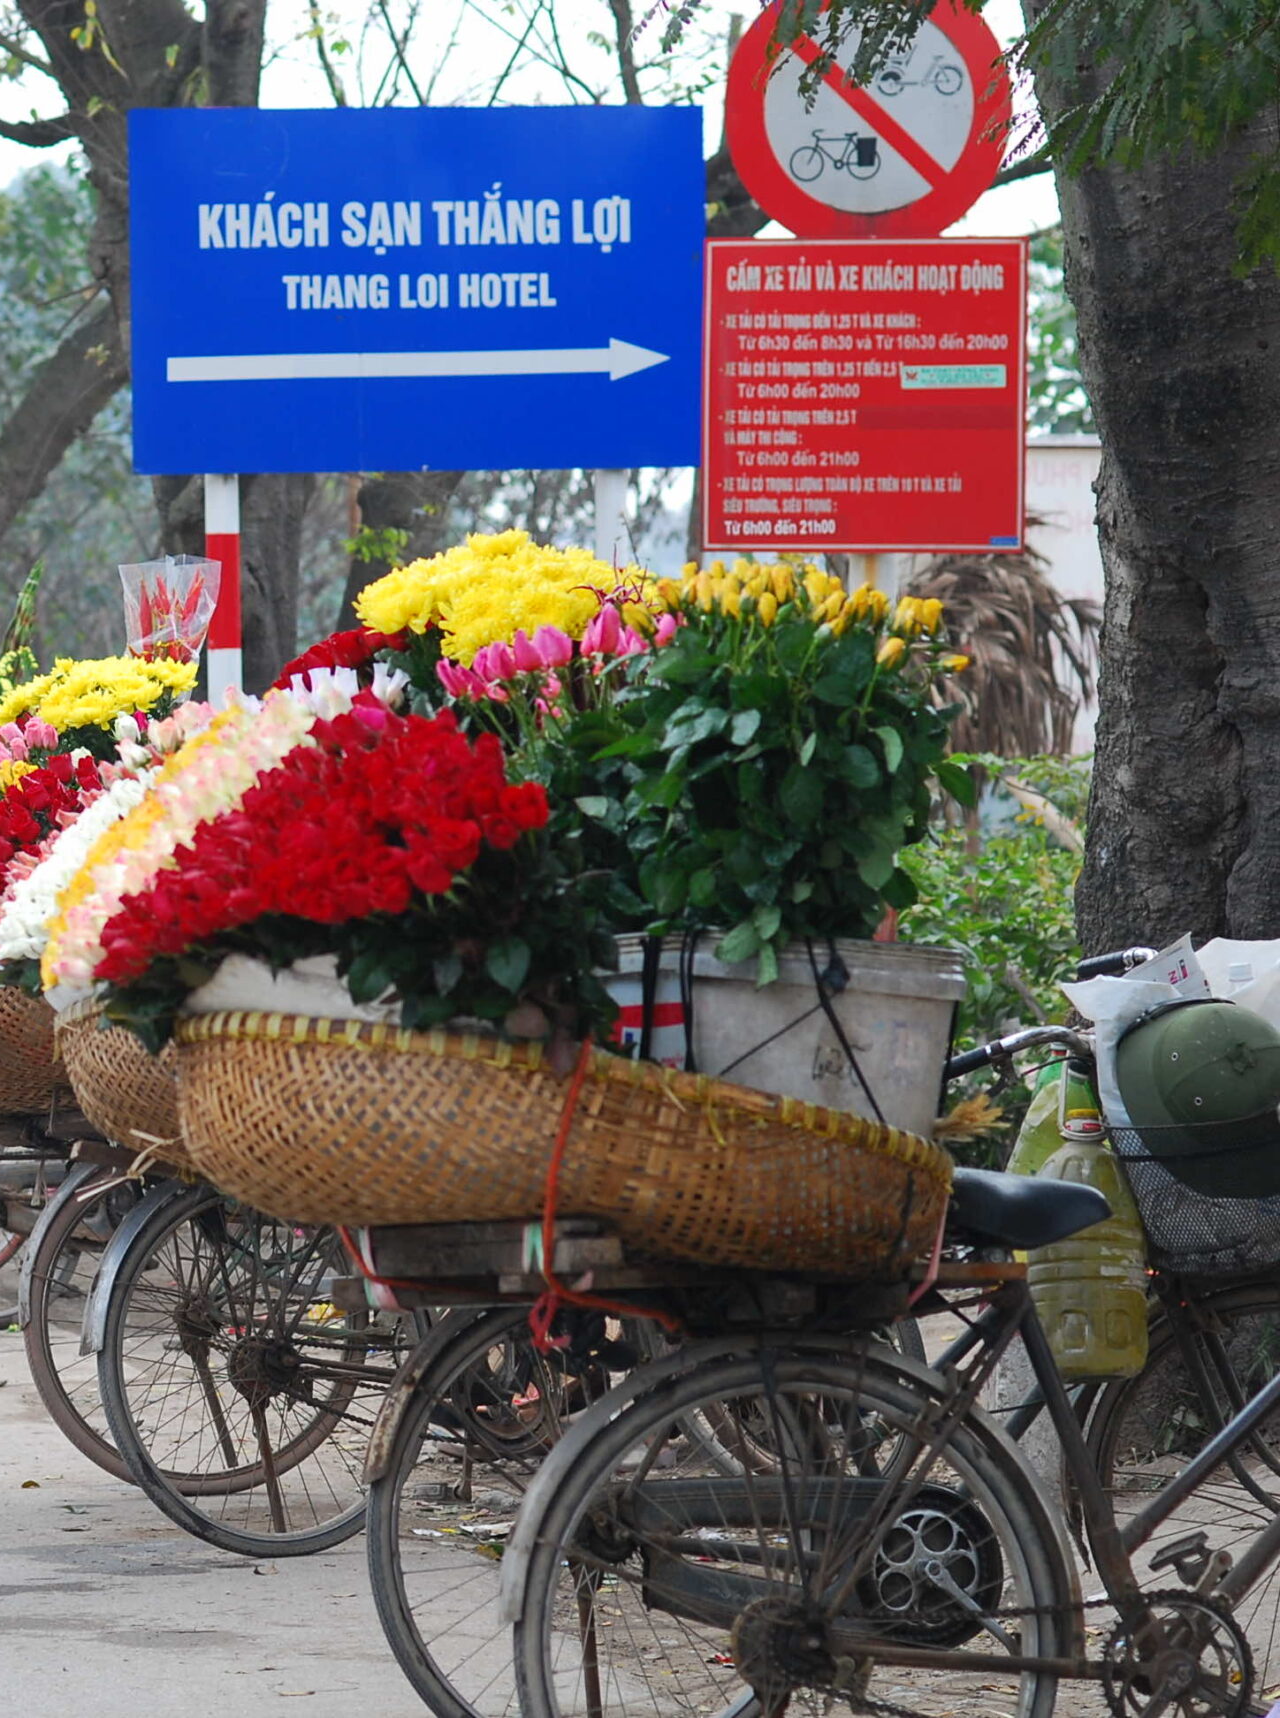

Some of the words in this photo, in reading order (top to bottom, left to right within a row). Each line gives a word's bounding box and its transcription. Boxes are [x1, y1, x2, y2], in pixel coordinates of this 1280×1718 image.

[198, 191, 329, 249] KHÁCH
[341, 201, 421, 255] SẠN
[432, 182, 560, 246] THẮNG
[572, 195, 631, 253] LỢI
[726, 258, 761, 292] CẤM
[764, 265, 785, 291] XE
[787, 256, 812, 291] TẢI
[815, 259, 836, 291] VÀ
[838, 265, 859, 291] XE
[862, 259, 914, 291] KHÁCH
[917, 265, 958, 295] HOẠT
[961, 259, 1005, 295] ĐỘNG
[282, 274, 389, 310] THANG
[399, 274, 448, 309] LOI
[459, 273, 557, 308] HOTEL
[738, 335, 757, 350] Từ
[758, 334, 790, 350] 6h30
[792, 332, 818, 350] đến
[855, 334, 872, 350] và
[875, 334, 894, 350] Từ
[896, 334, 936, 350] 16h30
[938, 332, 964, 350] đến
[966, 333, 1008, 350] 20h00
[737, 383, 756, 398] Từ
[757, 382, 789, 398] 6h00
[792, 380, 818, 398] đến
[819, 382, 860, 398] 20h00
[736, 450, 755, 466] Từ
[756, 450, 789, 466] 6h00
[791, 449, 817, 466] đến
[819, 450, 860, 466] 21h00
[724, 520, 741, 535] Từ
[742, 519, 772, 535] 6h00
[773, 518, 798, 535] đến
[799, 519, 836, 535] 21h00
